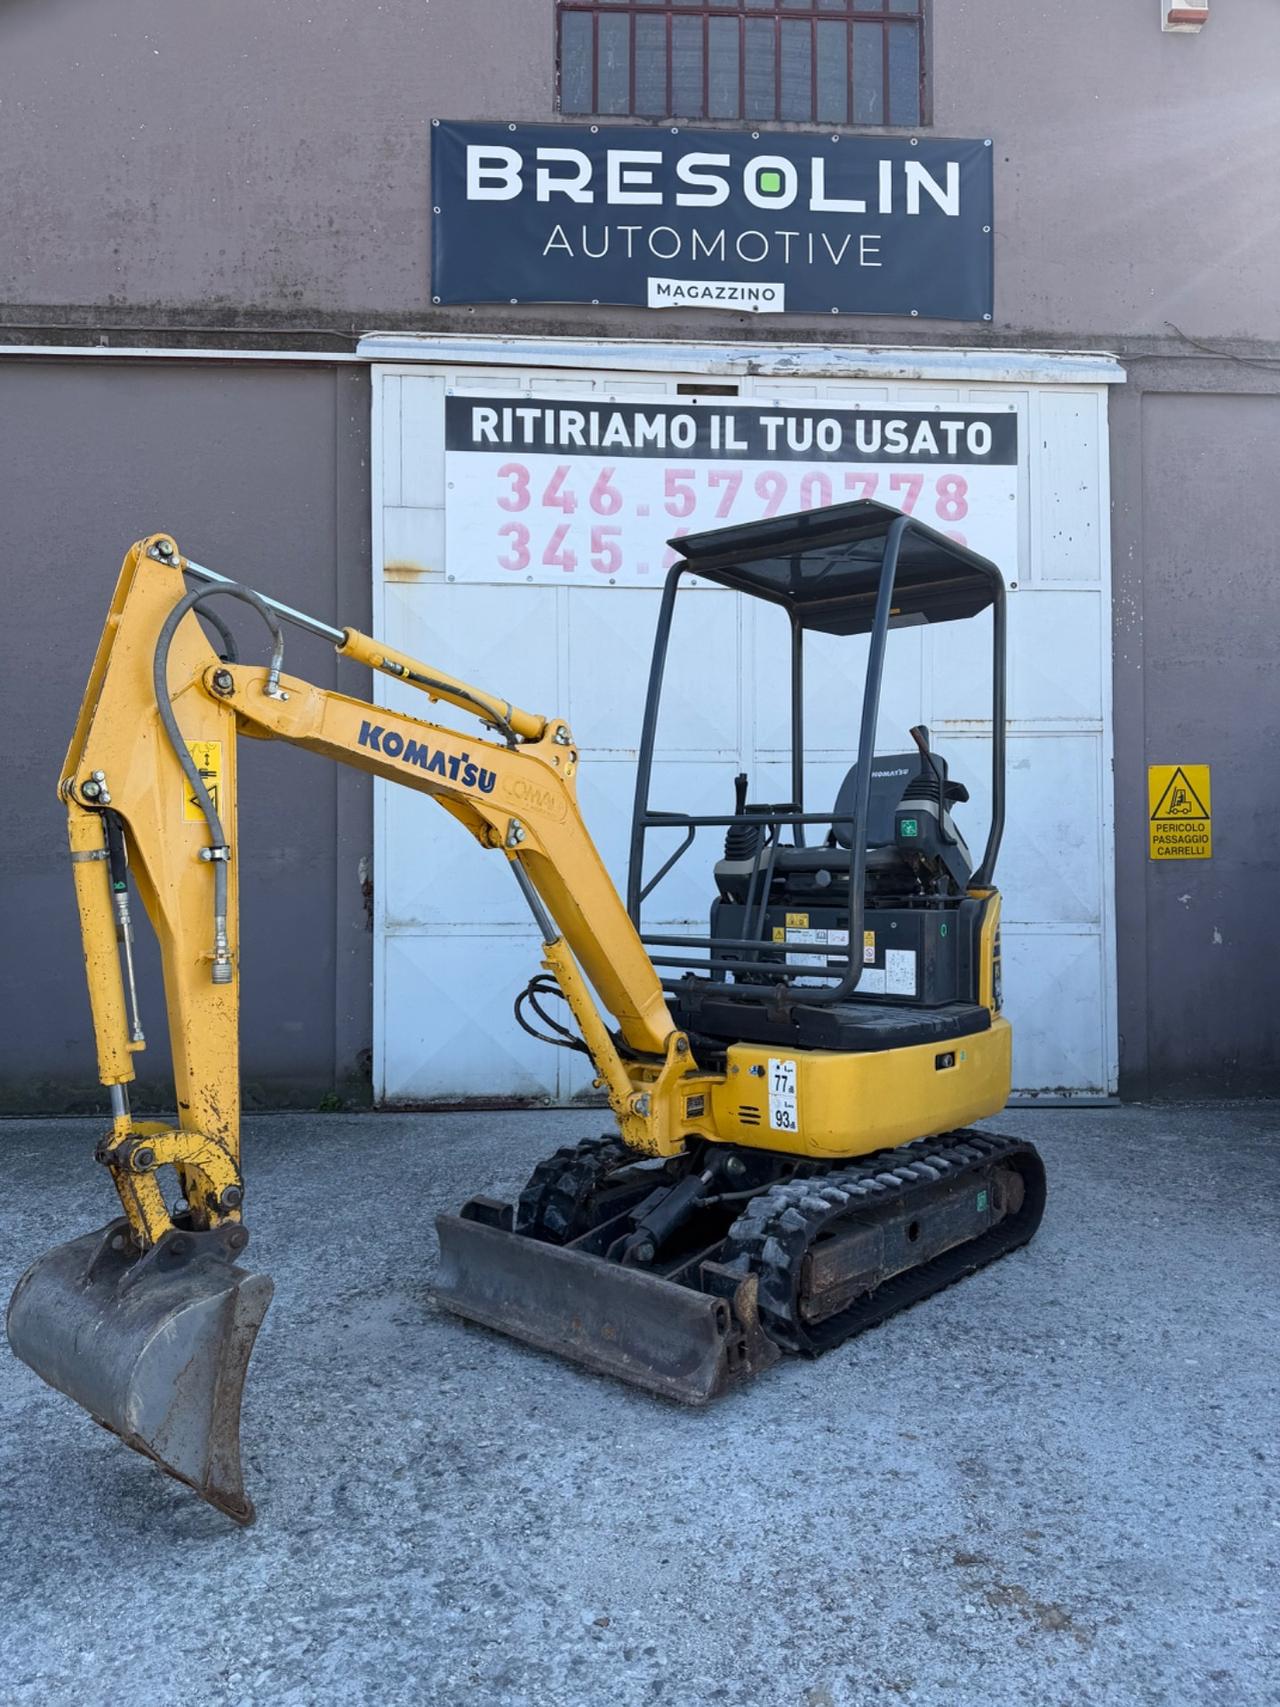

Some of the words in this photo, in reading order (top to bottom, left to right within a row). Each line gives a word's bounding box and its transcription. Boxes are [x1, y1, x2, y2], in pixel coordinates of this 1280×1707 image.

[467, 145, 959, 215] BRESOLIN
[543, 224, 882, 266] AUTOMOTIVE
[656, 282, 776, 301] MAGAZZINO
[471, 408, 697, 449] RITIRIAMO
[710, 414, 747, 450] IL
[760, 416, 842, 452] TUO
[856, 419, 992, 455] USATO
[358, 720, 497, 794] KOMATSU
[1156, 823, 1205, 832] PERICOLO
[1153, 834, 1209, 844] PASSAGGIO
[1157, 846, 1205, 855] CARRELLI
[774, 1074, 788, 1093] 77
[775, 1110, 790, 1128] 93
